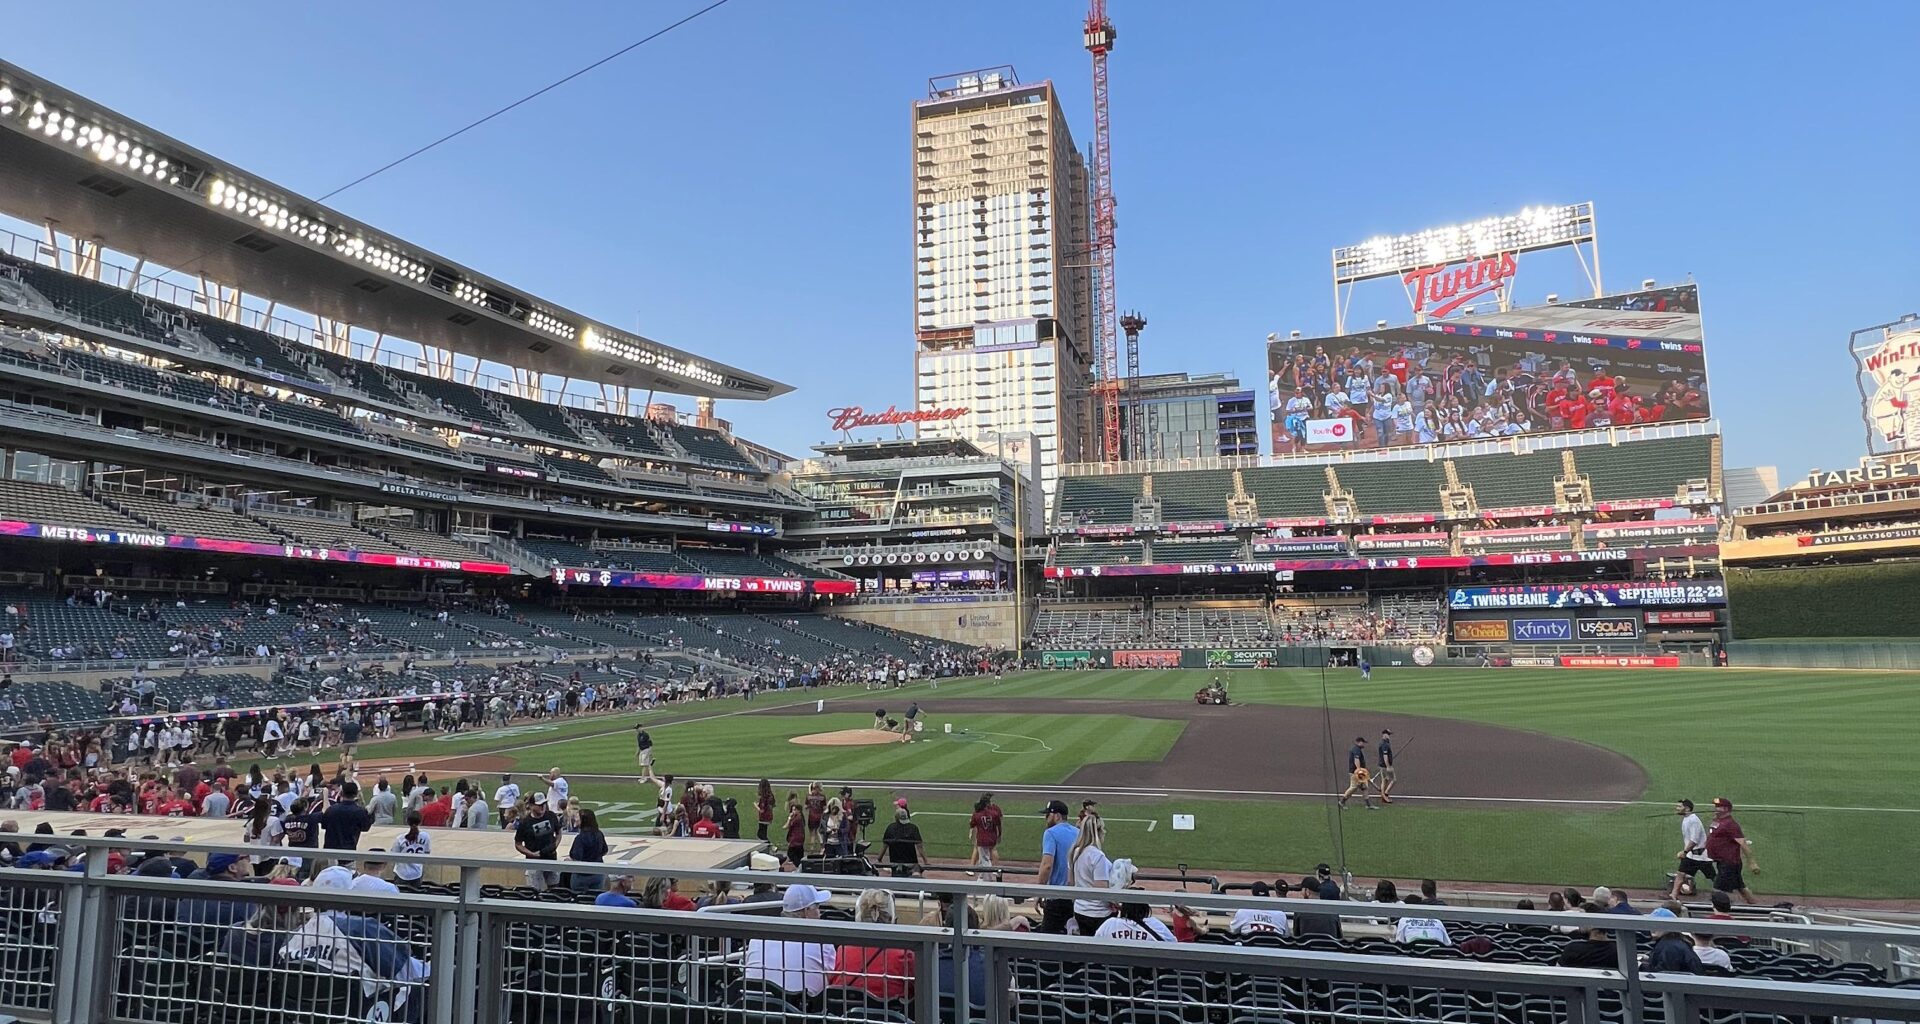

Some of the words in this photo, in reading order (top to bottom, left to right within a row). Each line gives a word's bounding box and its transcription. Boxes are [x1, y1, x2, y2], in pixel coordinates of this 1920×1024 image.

[1404, 252, 1517, 318] Twins
[1495, 329, 1528, 340] twins.com
[1572, 334, 1608, 345] twins.com
[1660, 341, 1700, 352] twins.com
[1866, 344, 1906, 371] Win!
[827, 406, 969, 430] Budweiser
[1808, 460, 1920, 487] TARGET
[390, 485, 415, 495] DELTA
[42, 526, 88, 540] METS
[117, 532, 166, 546] TWINS
[1619, 528, 1650, 537] Home
[1653, 527, 1674, 536] Run
[1676, 525, 1706, 534] Deck
[1486, 536, 1529, 544] Treasure
[1530, 533, 1561, 542] Island
[1824, 534, 1855, 543] DELTA
[1312, 542, 1338, 551] Island
[1376, 540, 1401, 549] Home
[1403, 540, 1421, 548] Run
[1513, 553, 1552, 564] METS
[1578, 550, 1627, 561] TWINS
[396, 556, 420, 567] METS
[434, 561, 461, 570] TWINS
[1182, 564, 1216, 573] METS
[1237, 562, 1276, 572] TWINS
[705, 578, 741, 589] METS
[763, 580, 802, 591] TWINS
[1581, 581, 1678, 590] PROMOTIONS
[1619, 587, 1685, 600] SEPTEMBER
[1687, 585, 1723, 598] 22-23
[1472, 594, 1508, 606] TWINS
[1509, 593, 1549, 605] BEANIE
[1471, 628, 1505, 638] Cheerios
[1518, 622, 1567, 637] xfinity
[1254, 914, 1272, 923] LEWIS
[1112, 930, 1148, 941] KEPLER
